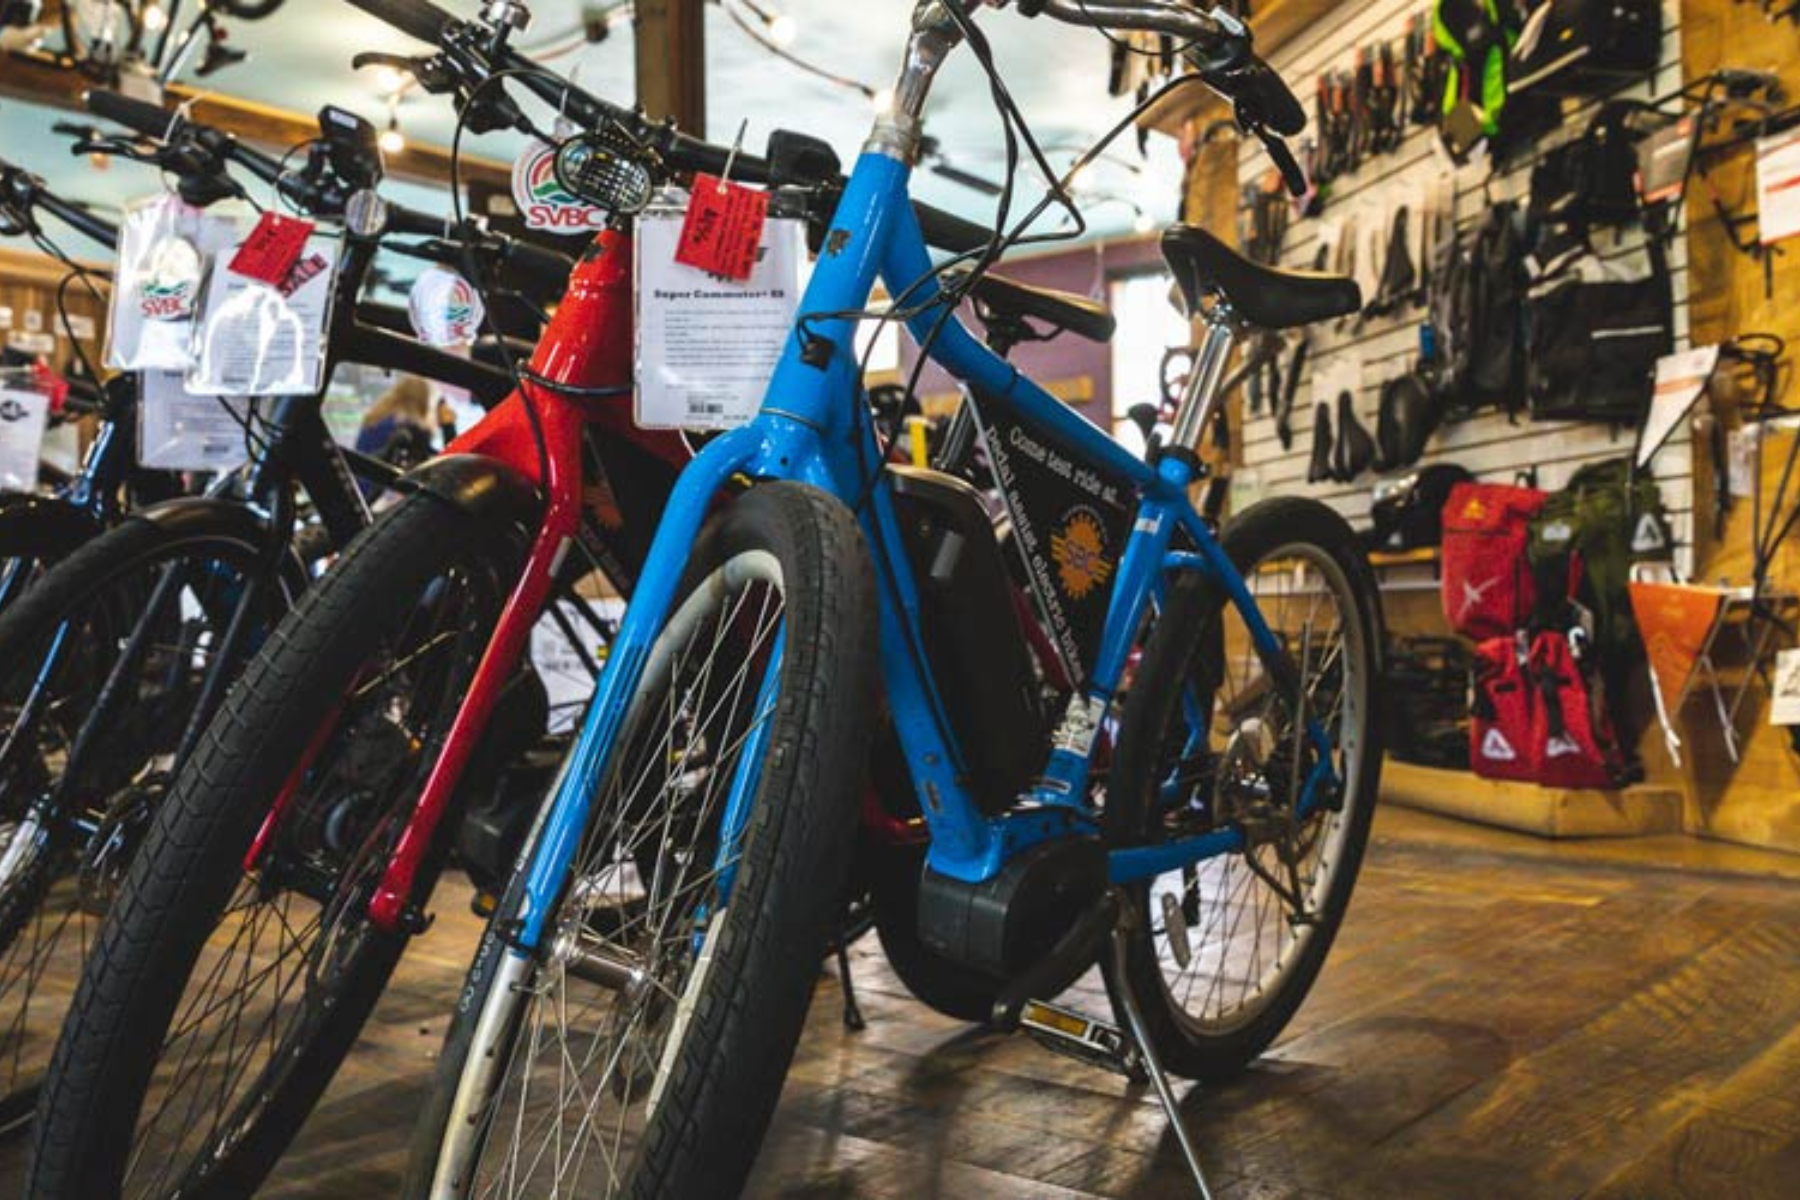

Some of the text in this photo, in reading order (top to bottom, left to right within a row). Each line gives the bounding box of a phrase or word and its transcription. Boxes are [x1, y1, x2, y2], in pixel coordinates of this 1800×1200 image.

[529, 205, 603, 227] SVBC
[654, 289, 690, 300] Super
[1010, 426, 1046, 462] Come
[1047, 451, 1072, 479] test
[1073, 468, 1102, 495] ride
[986, 425, 1084, 683] Pedal assist electric bikes
